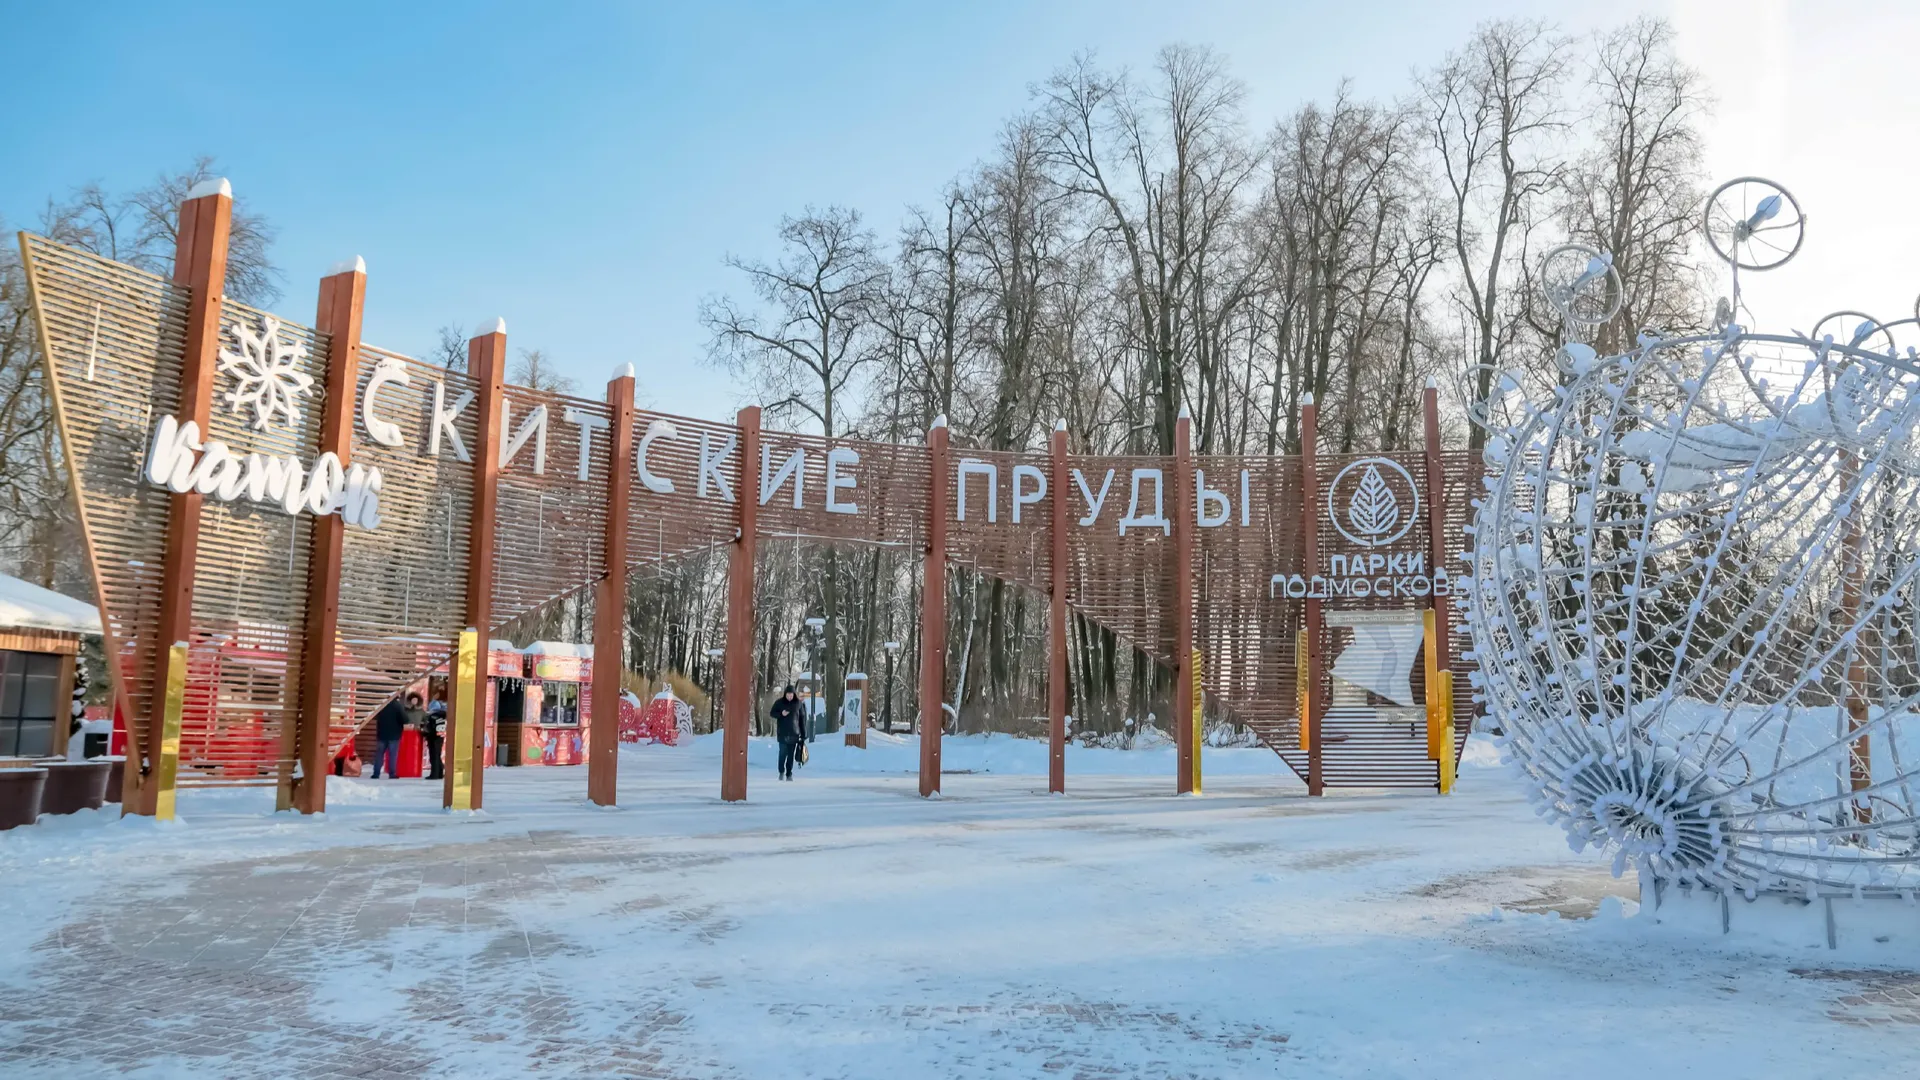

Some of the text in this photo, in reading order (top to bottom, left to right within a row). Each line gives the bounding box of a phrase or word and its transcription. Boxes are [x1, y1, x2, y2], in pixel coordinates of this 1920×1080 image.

[362, 358, 1250, 537] СКИТСКИЕ ПРУДЫ
[1330, 553, 1424, 576] ПАРКИ
[1270, 573, 1471, 599] ПОДМОСКОВЬ
